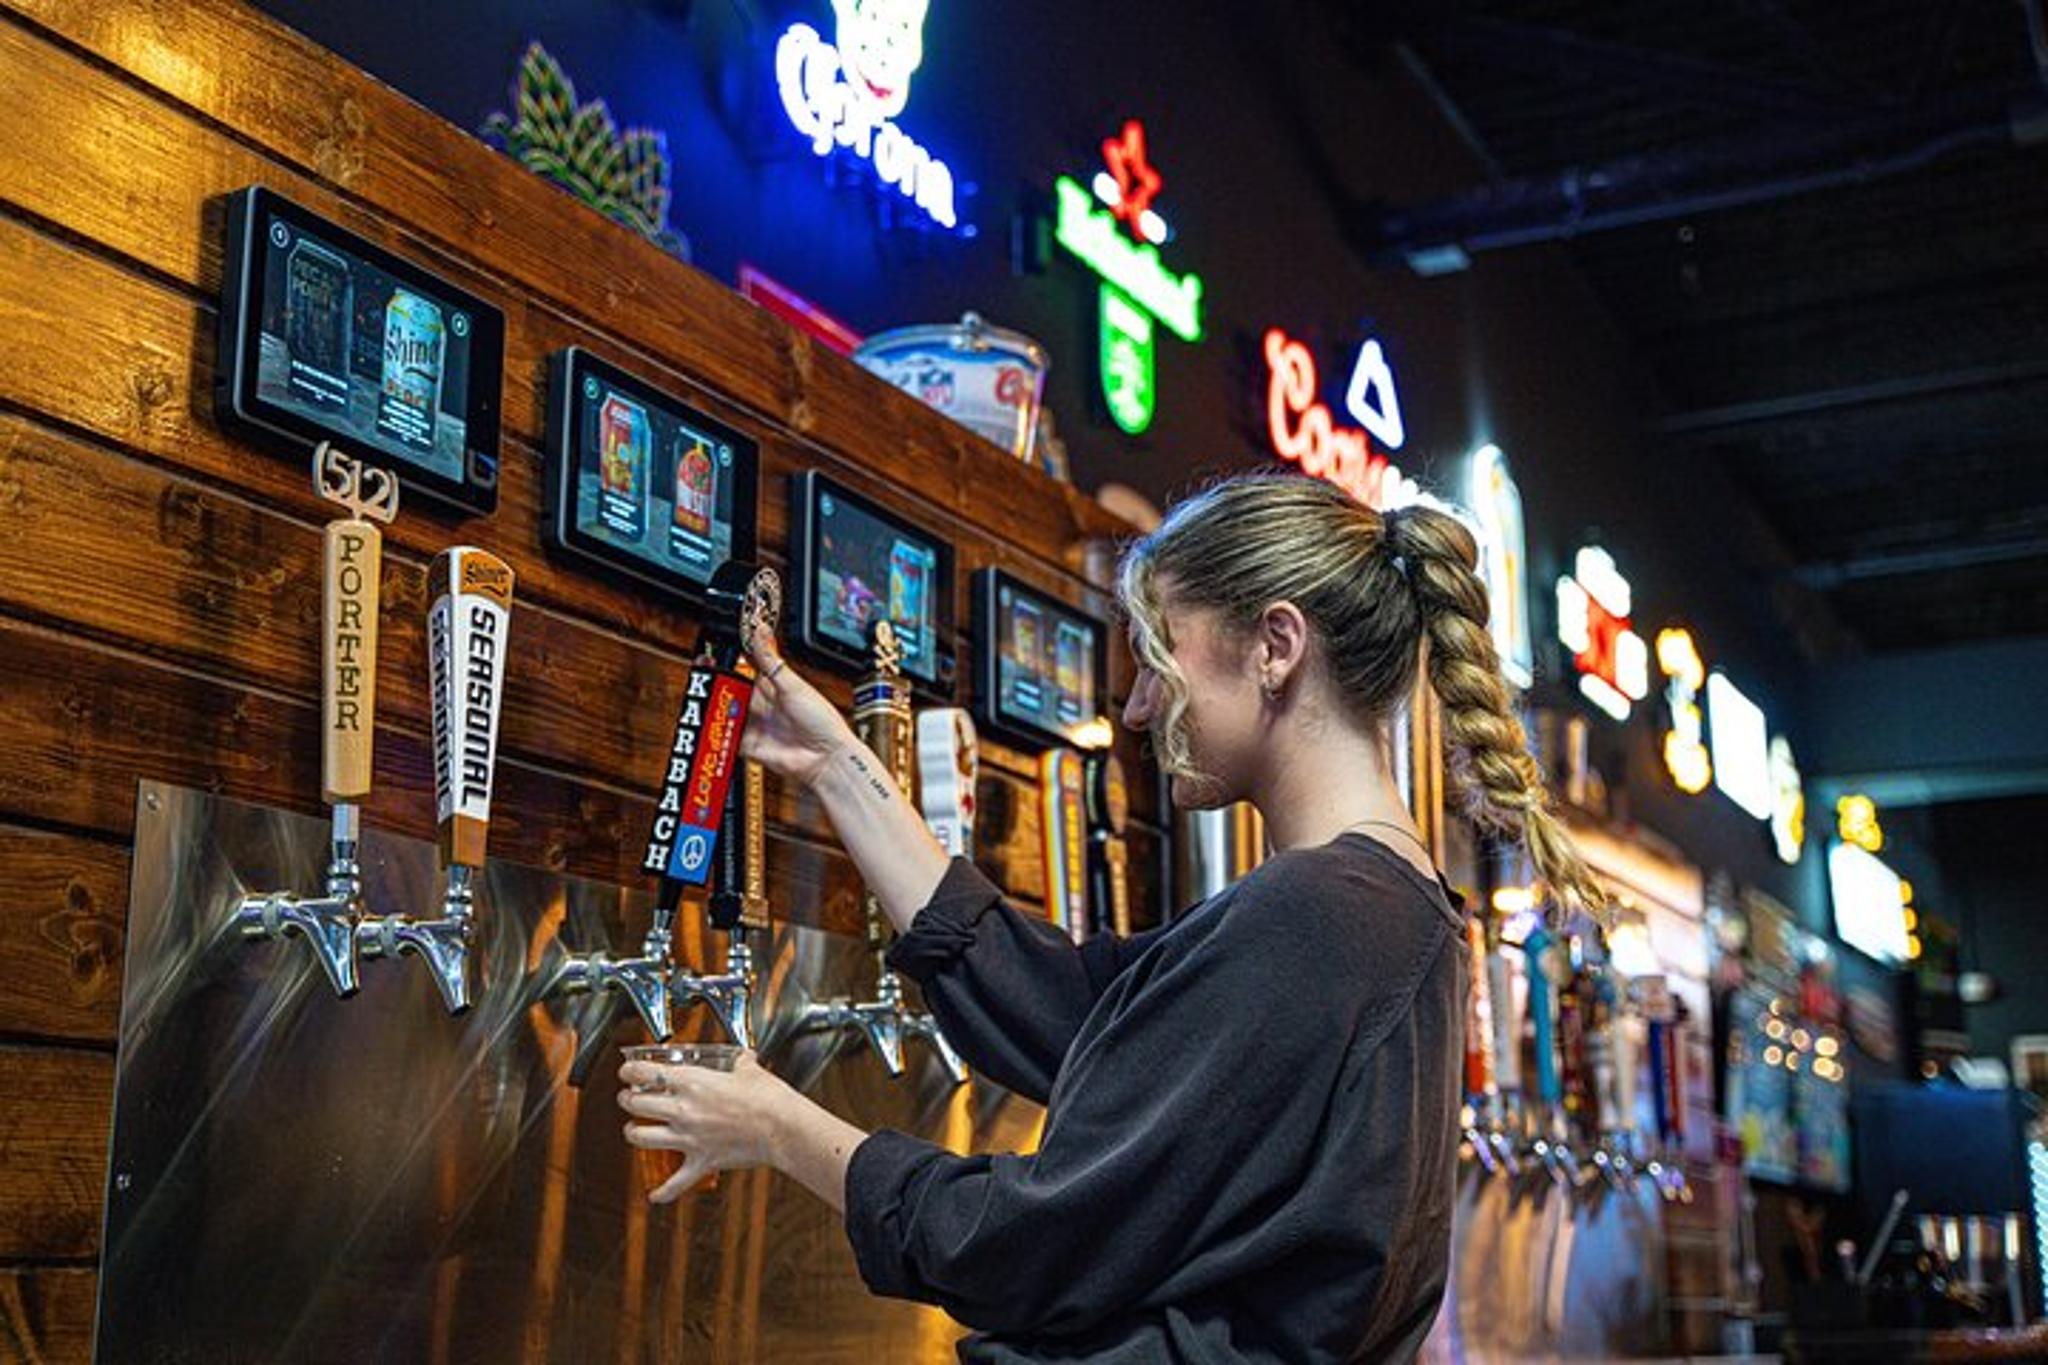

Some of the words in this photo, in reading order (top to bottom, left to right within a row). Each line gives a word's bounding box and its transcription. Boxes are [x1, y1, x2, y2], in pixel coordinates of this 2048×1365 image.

[313, 440, 399, 524] (512)
[334, 534, 364, 732] PORTER
[460, 605, 496, 807] SEASONAL
[644, 672, 712, 871] KARBACH
